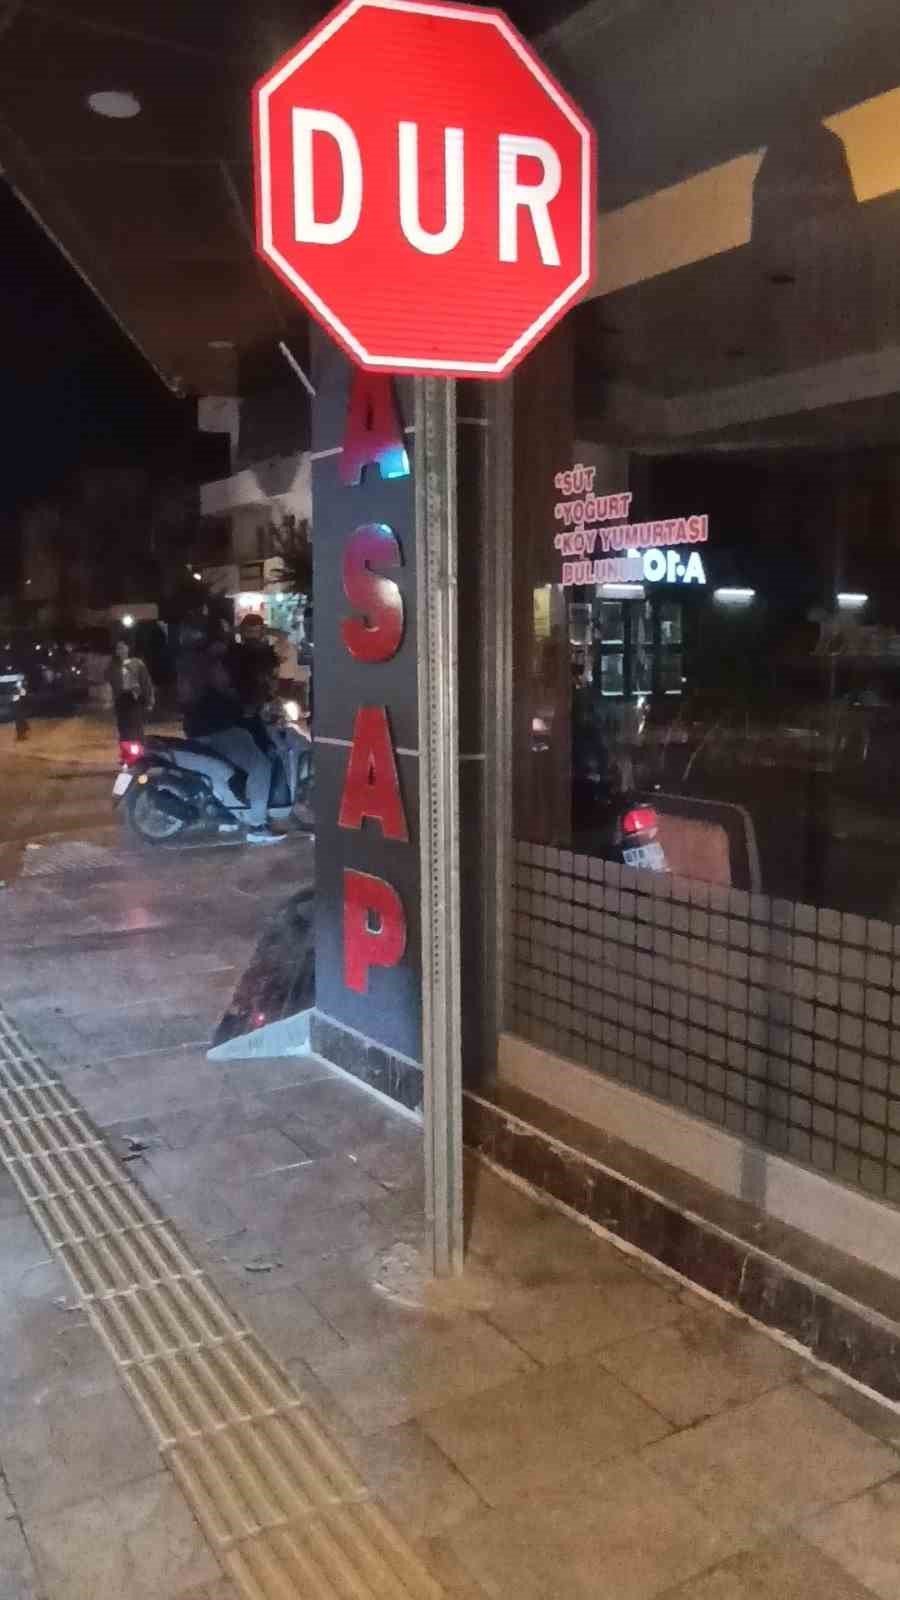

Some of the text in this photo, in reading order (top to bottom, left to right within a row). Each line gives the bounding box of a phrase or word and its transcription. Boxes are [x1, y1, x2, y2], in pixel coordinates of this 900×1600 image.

[292, 107, 562, 267] DUR
[561, 464, 595, 495] SÜT
[561, 493, 632, 525] YOĞURT
[600, 515, 708, 552] YUMURTASI
[338, 374, 411, 994] ASAP
